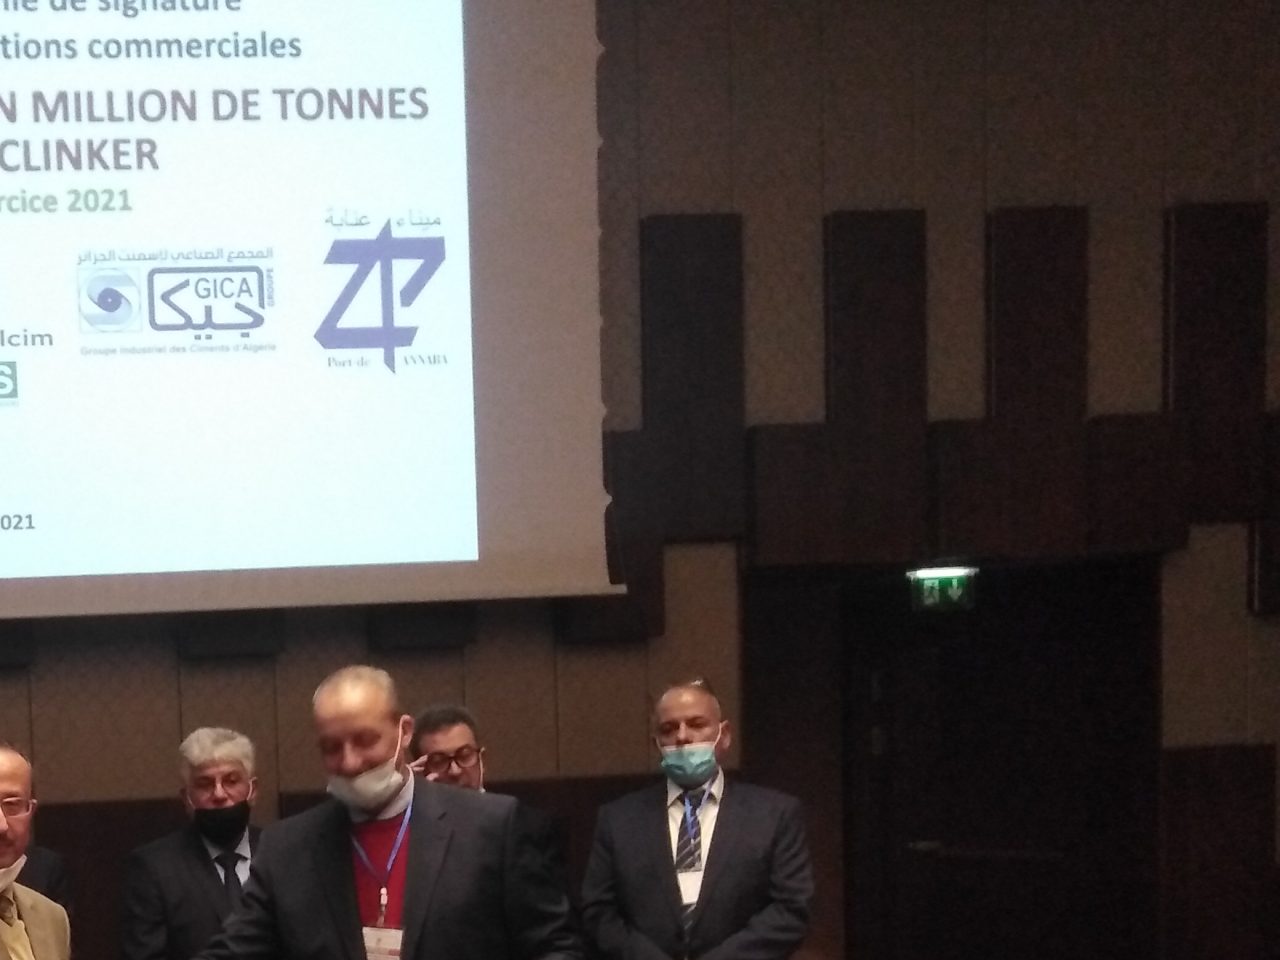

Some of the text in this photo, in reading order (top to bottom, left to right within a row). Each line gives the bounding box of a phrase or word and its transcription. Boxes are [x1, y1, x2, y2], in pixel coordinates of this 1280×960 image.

[87, 30, 302, 60] commerciales
[31, 88, 197, 124] MILLION
[212, 88, 261, 122] DE
[271, 86, 429, 121] TONNES
[66, 188, 133, 213] 2021
[194, 277, 254, 300] GICA
